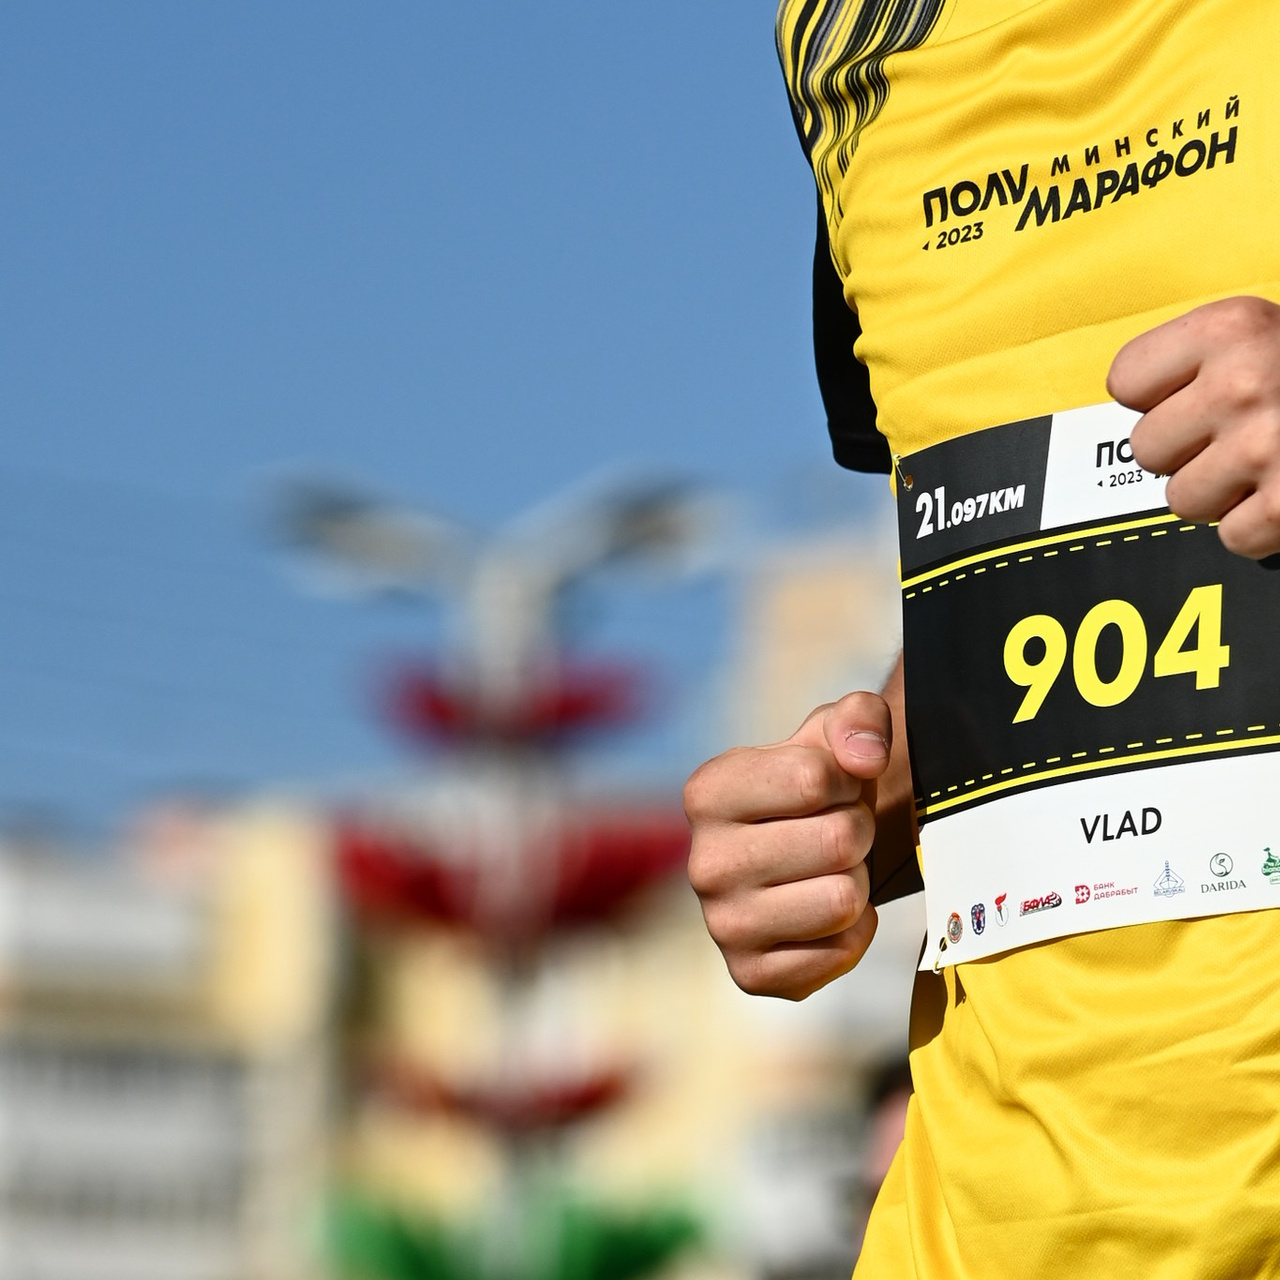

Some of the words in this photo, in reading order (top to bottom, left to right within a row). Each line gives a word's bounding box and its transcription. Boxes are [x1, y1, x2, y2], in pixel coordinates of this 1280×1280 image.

[1050, 94, 1240, 177] МИНСКИЙ
[1014, 125, 1238, 232] МАРАФОН
[936, 221, 984, 250] 2023
[1096, 437, 1136, 468] ПО
[1109, 469, 1143, 487] 2023
[1003, 583, 1231, 725] 904
[1080, 806, 1163, 844] VLAD
[1093, 881, 1115, 891] БАНК
[1093, 887, 1139, 901] ДАБРАБЫТ
[1200, 879, 1247, 894] DARIDA
